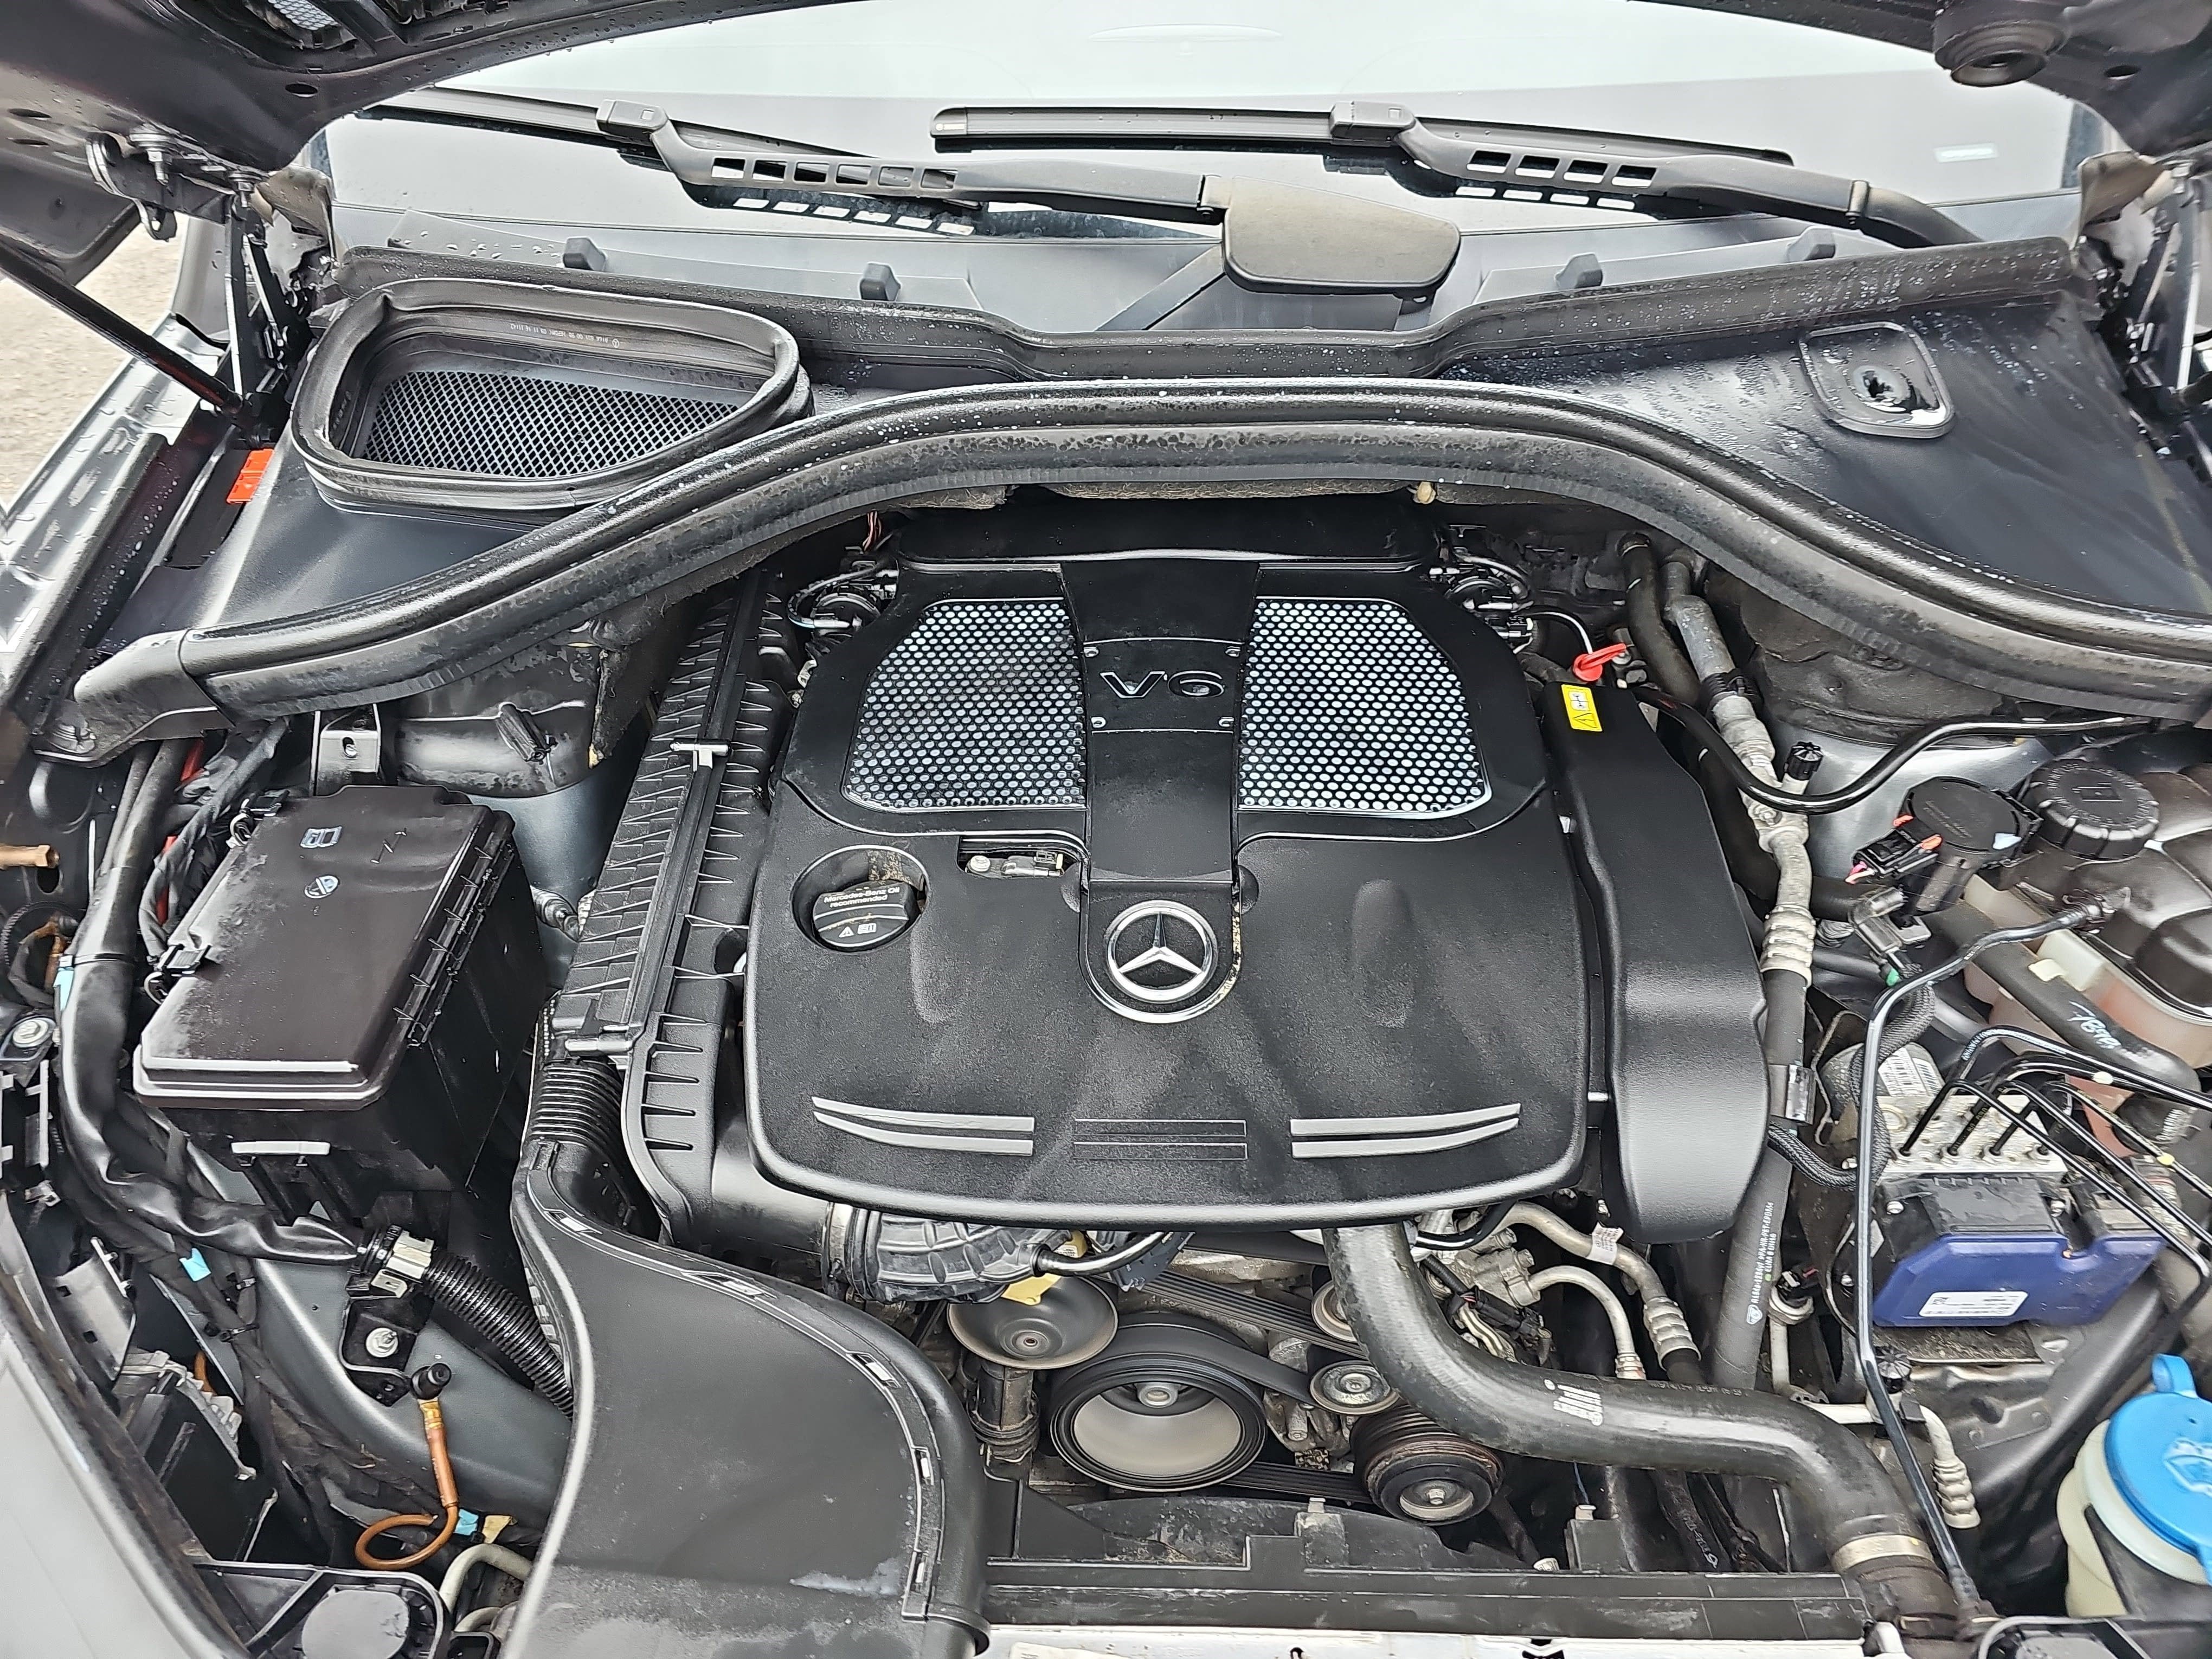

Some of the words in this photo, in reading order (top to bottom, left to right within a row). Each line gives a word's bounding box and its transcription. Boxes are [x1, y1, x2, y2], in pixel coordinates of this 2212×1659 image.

[1099, 670, 1225, 698] V6
[824, 889, 887, 903] Mercedes-Benz
[829, 894, 888, 908] recommended
